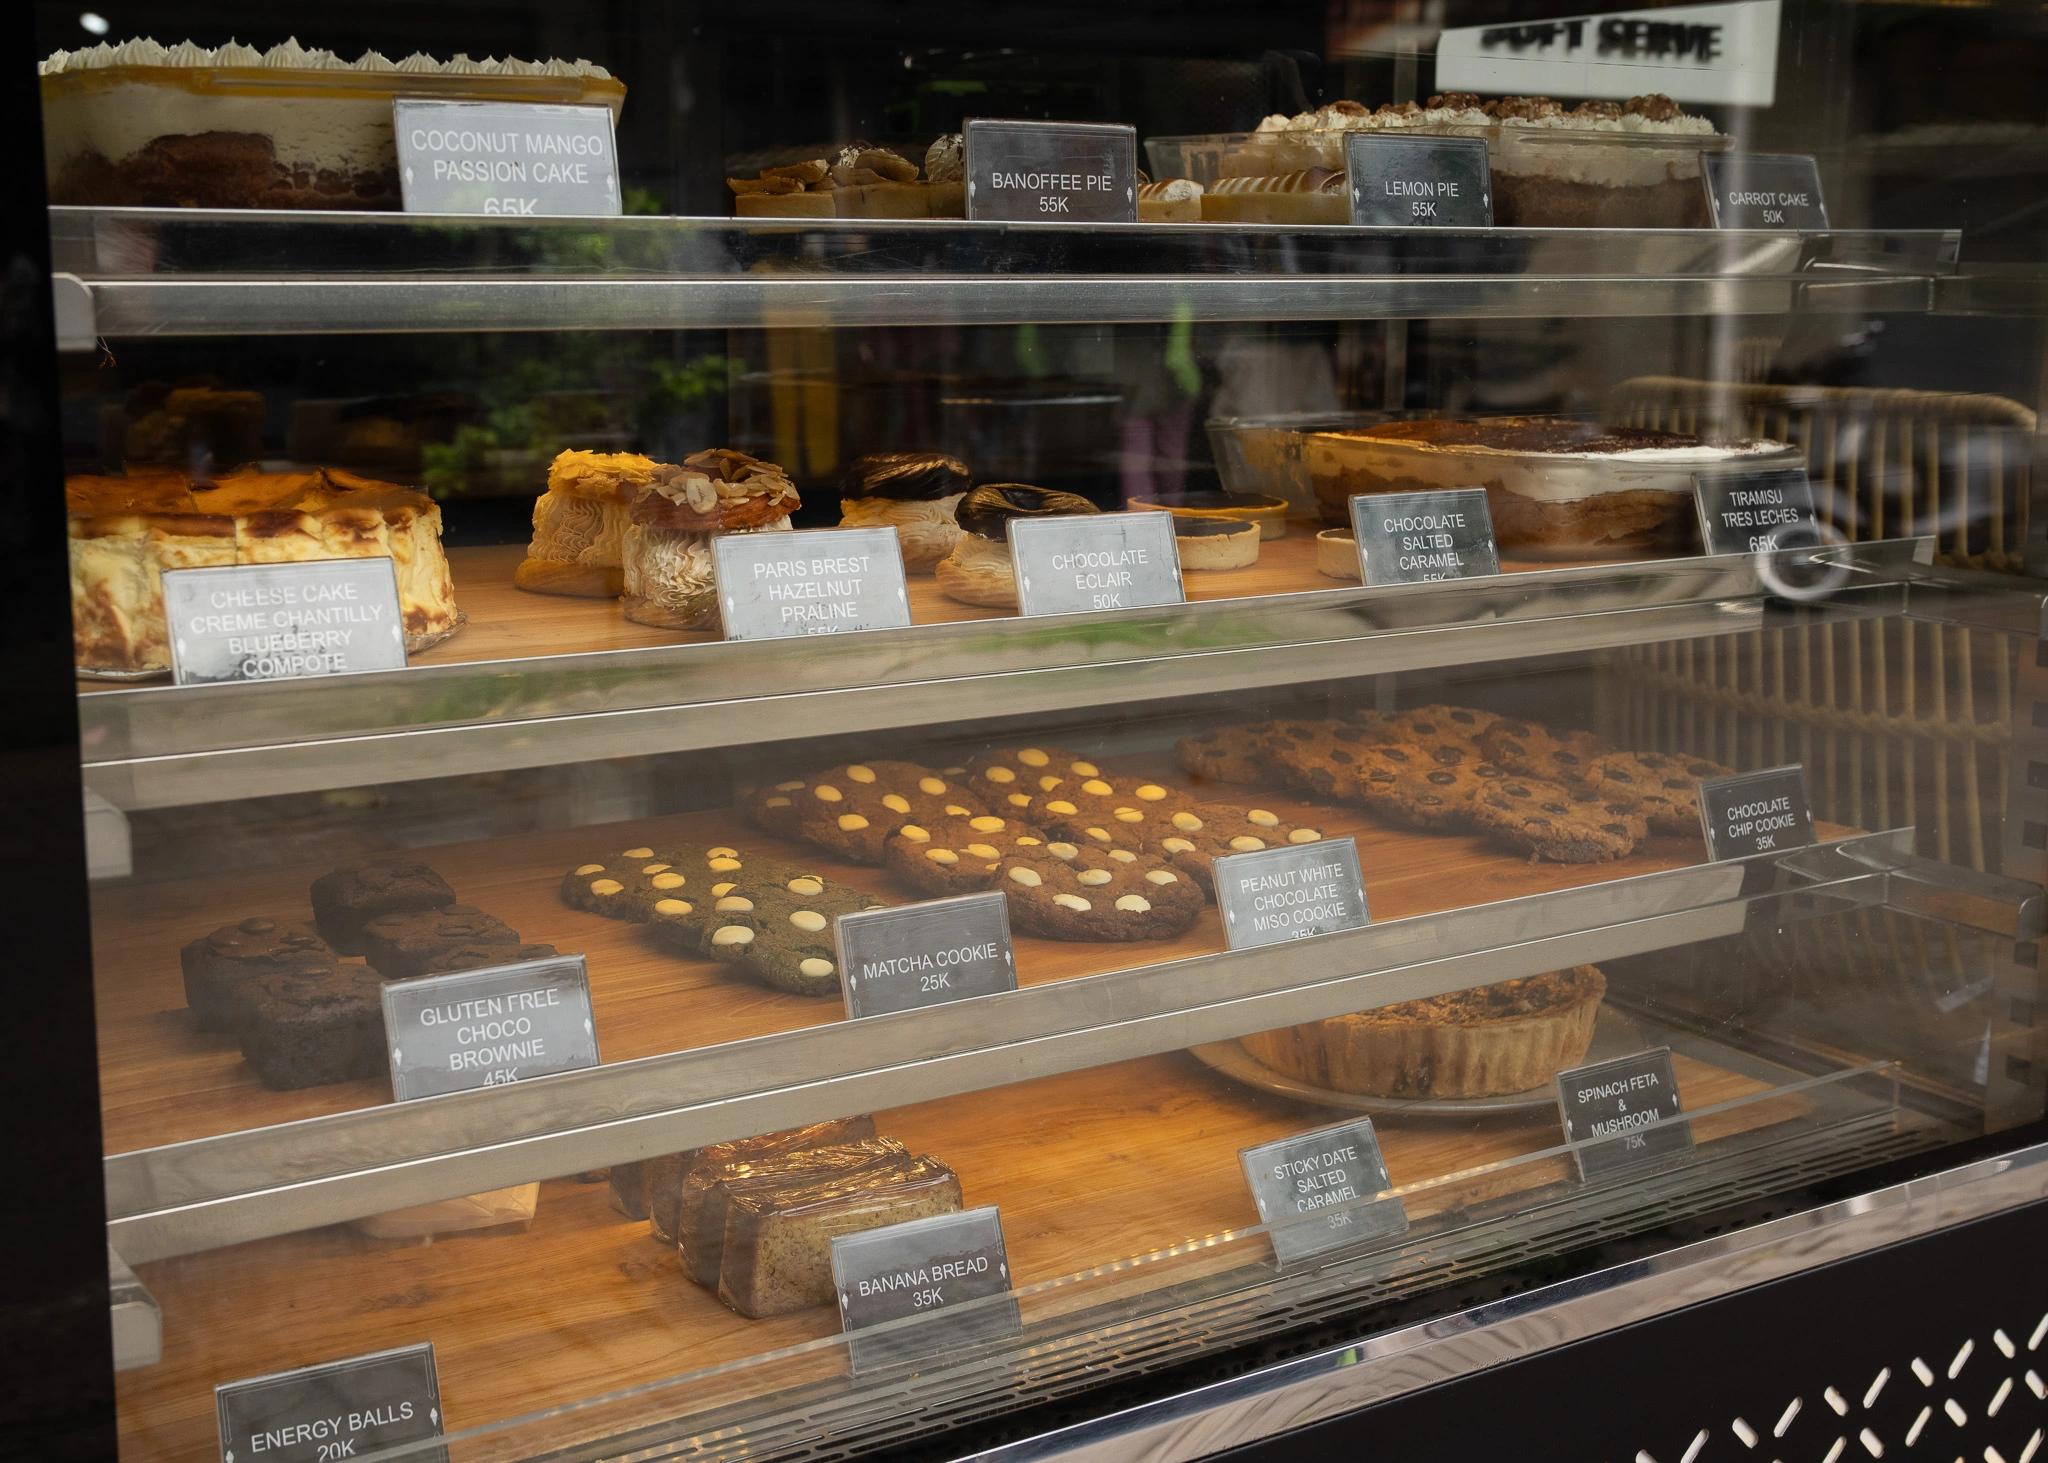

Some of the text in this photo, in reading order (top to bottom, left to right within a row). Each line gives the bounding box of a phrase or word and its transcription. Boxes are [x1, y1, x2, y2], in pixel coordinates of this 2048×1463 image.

[412, 130, 603, 156] COCONUT MANGO
[433, 160, 589, 184] PASSION CAKE
[992, 172, 1112, 191] BANOFFEE PIE
[1385, 181, 1459, 197] LEMON PIE
[1729, 191, 1809, 207] CARROT CAKE
[1039, 196, 1069, 213] 55K
[1412, 202, 1437, 217] 55K
[1763, 210, 1784, 223] 50K
[1729, 489, 1783, 507] TIRAMISU
[1384, 514, 1466, 533] CHOCOLATE
[1721, 508, 1799, 528] TRES LECHES
[1403, 534, 1453, 551] SALTED
[1749, 534, 1779, 553] 65K
[753, 556, 870, 579] PARIS BREST
[1052, 549, 1149, 570] CHOCOLATE
[1400, 552, 1464, 570] CARAMEL
[768, 579, 863, 600] HAZELNUT
[1075, 571, 1133, 590] ECLAIR
[211, 583, 359, 609] CHEESE CAKE
[1093, 593, 1121, 610] 50K
[190, 604, 383, 634] CREME CHANTILLY
[781, 602, 858, 623] PRALINE
[228, 629, 352, 655] BLUEBERRY
[242, 653, 348, 678] COMPOTE
[1727, 796, 1790, 821] CHOCOLATE
[1728, 813, 1796, 838] CHIP COOKIE
[1755, 834, 1776, 850] 35K
[1240, 863, 1344, 893] PEANUT WHITE
[1254, 883, 1338, 911] CHOCOLATE
[1253, 902, 1346, 932] MISO COOKIE
[863, 942, 998, 980] MATCHA COOKIE
[920, 972, 951, 992] 25K
[420, 988, 560, 1026] GLUTEN FREE
[457, 1017, 531, 1045] CHOCO
[449, 1038, 546, 1071] BROWNIE
[483, 1066, 518, 1086] 45K
[1577, 1072, 1659, 1104] SPINACH FETA
[1618, 1098, 1627, 1112] &
[1591, 1108, 1660, 1138] MUSHROOM
[1624, 1133, 1646, 1151] 75K
[1274, 1146, 1358, 1180] STICKY DATE
[1296, 1169, 1347, 1194] SALTED
[1297, 1185, 1360, 1212] CARAMEL
[859, 1256, 988, 1297] BANANA BREAD
[912, 1287, 944, 1307] 35K
[251, 1401, 414, 1453] ENERGY BALLS
[317, 1438, 356, 1463] 20K
